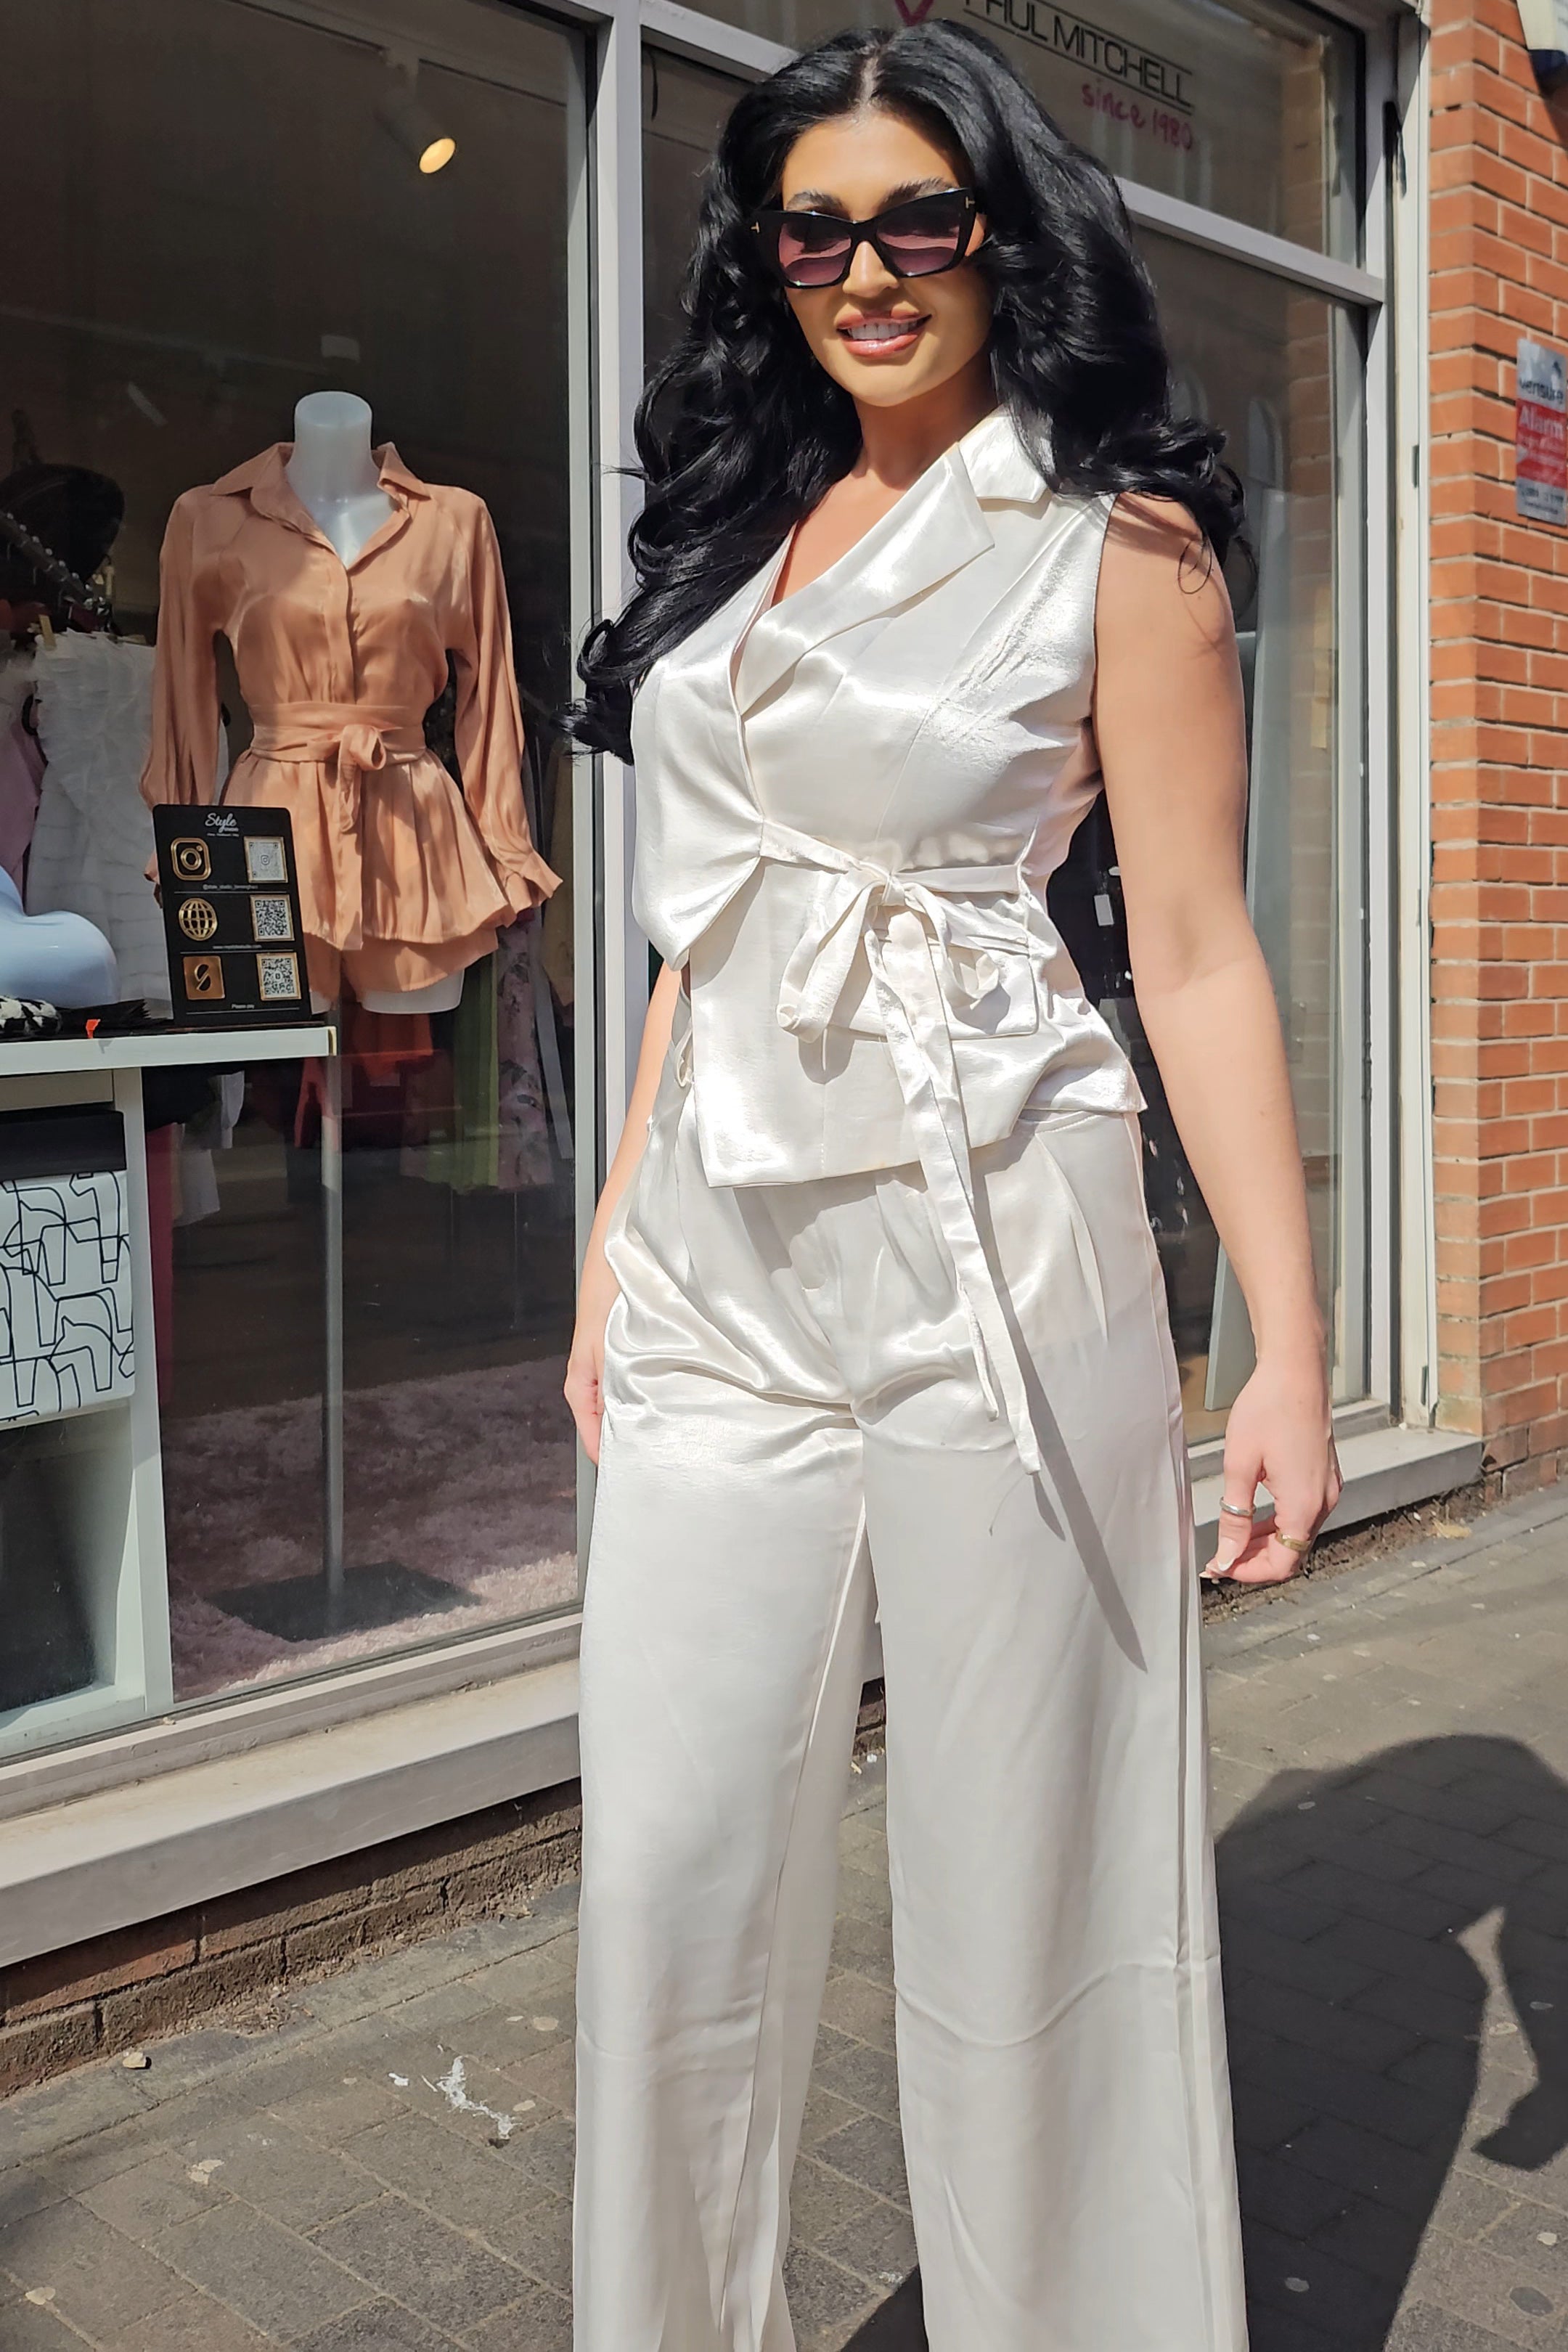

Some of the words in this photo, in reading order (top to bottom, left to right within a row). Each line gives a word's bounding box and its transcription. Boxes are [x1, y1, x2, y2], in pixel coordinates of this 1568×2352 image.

[1053, 15, 1193, 107] MITCHELL
[1082, 79, 1146, 128] since
[1152, 107, 1193, 151] 1980
[205, 812, 237, 833] Style
